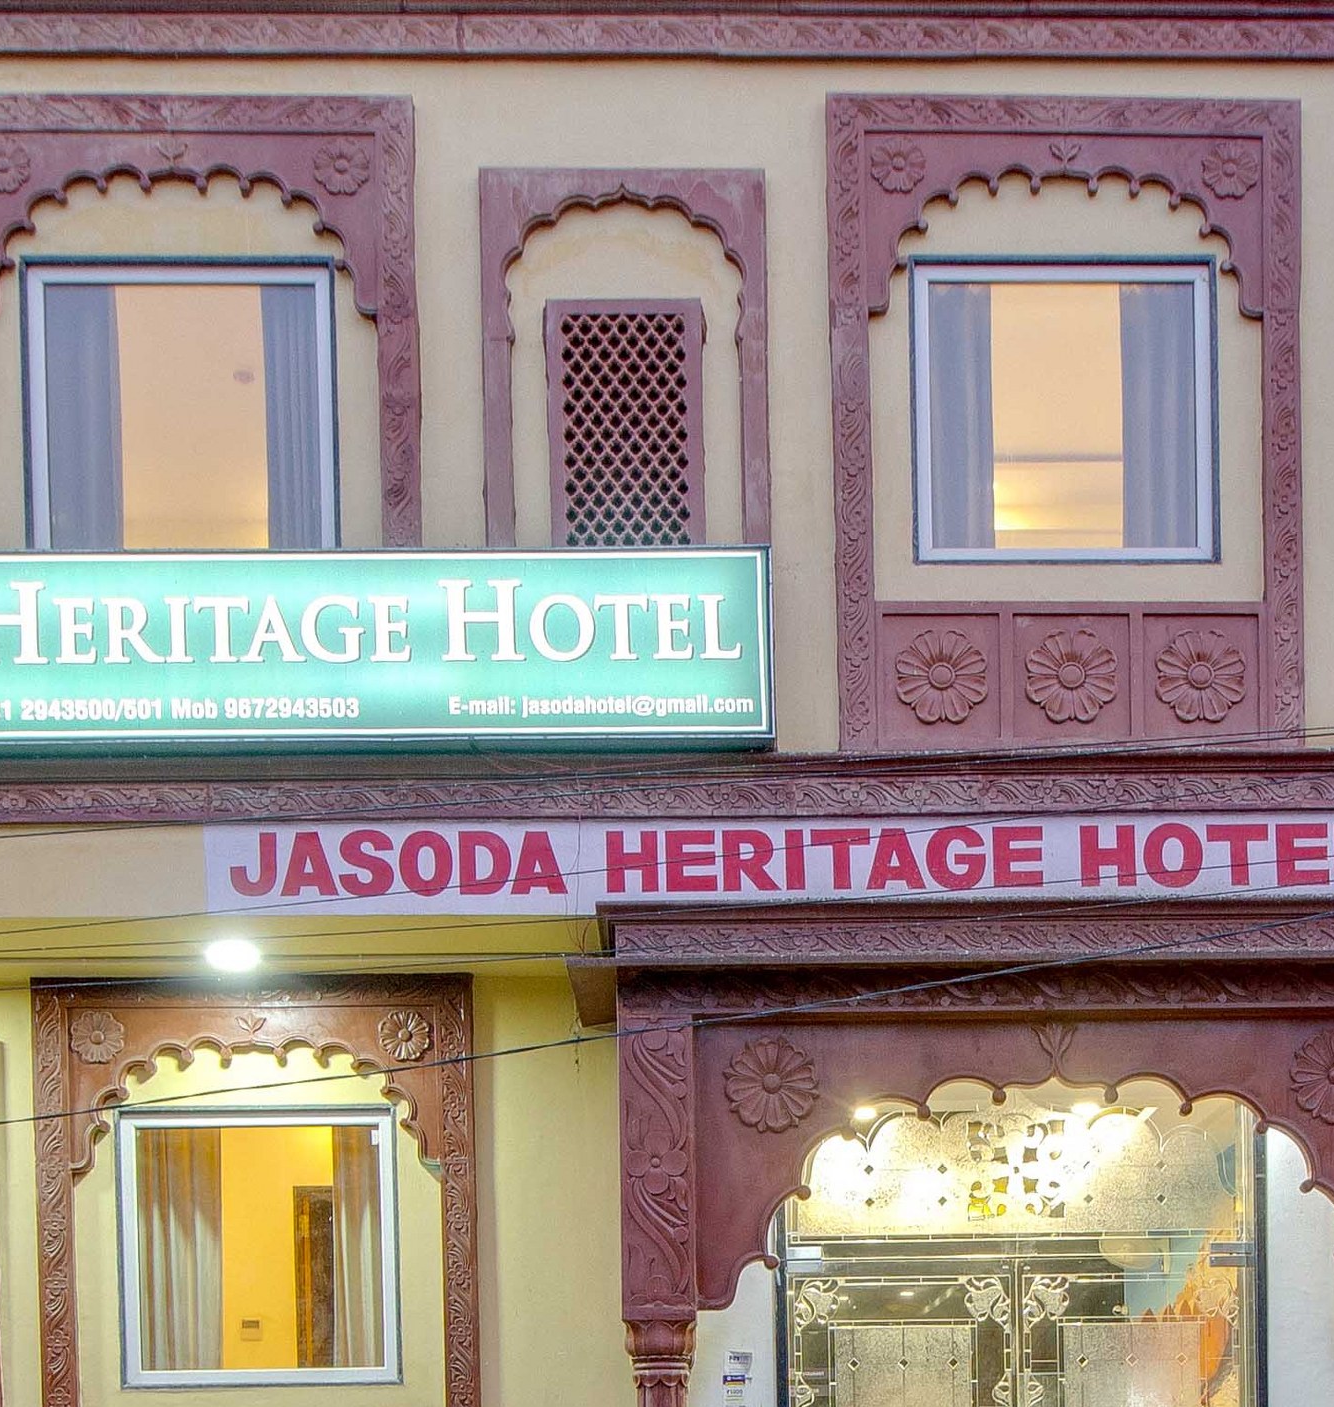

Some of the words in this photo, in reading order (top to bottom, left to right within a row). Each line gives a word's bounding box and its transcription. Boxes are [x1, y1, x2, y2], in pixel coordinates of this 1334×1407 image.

[437, 578, 742, 663] HOTEL
[20, 698, 161, 721] 2943500/501
[171, 697, 218, 719] Mob
[224, 697, 359, 718] 9672943503
[448, 695, 516, 715] E-mail:
[522, 694, 754, 718] jasodahotel@gmail.com
[229, 829, 569, 897] JASODA
[605, 825, 1044, 892] HERITAGE
